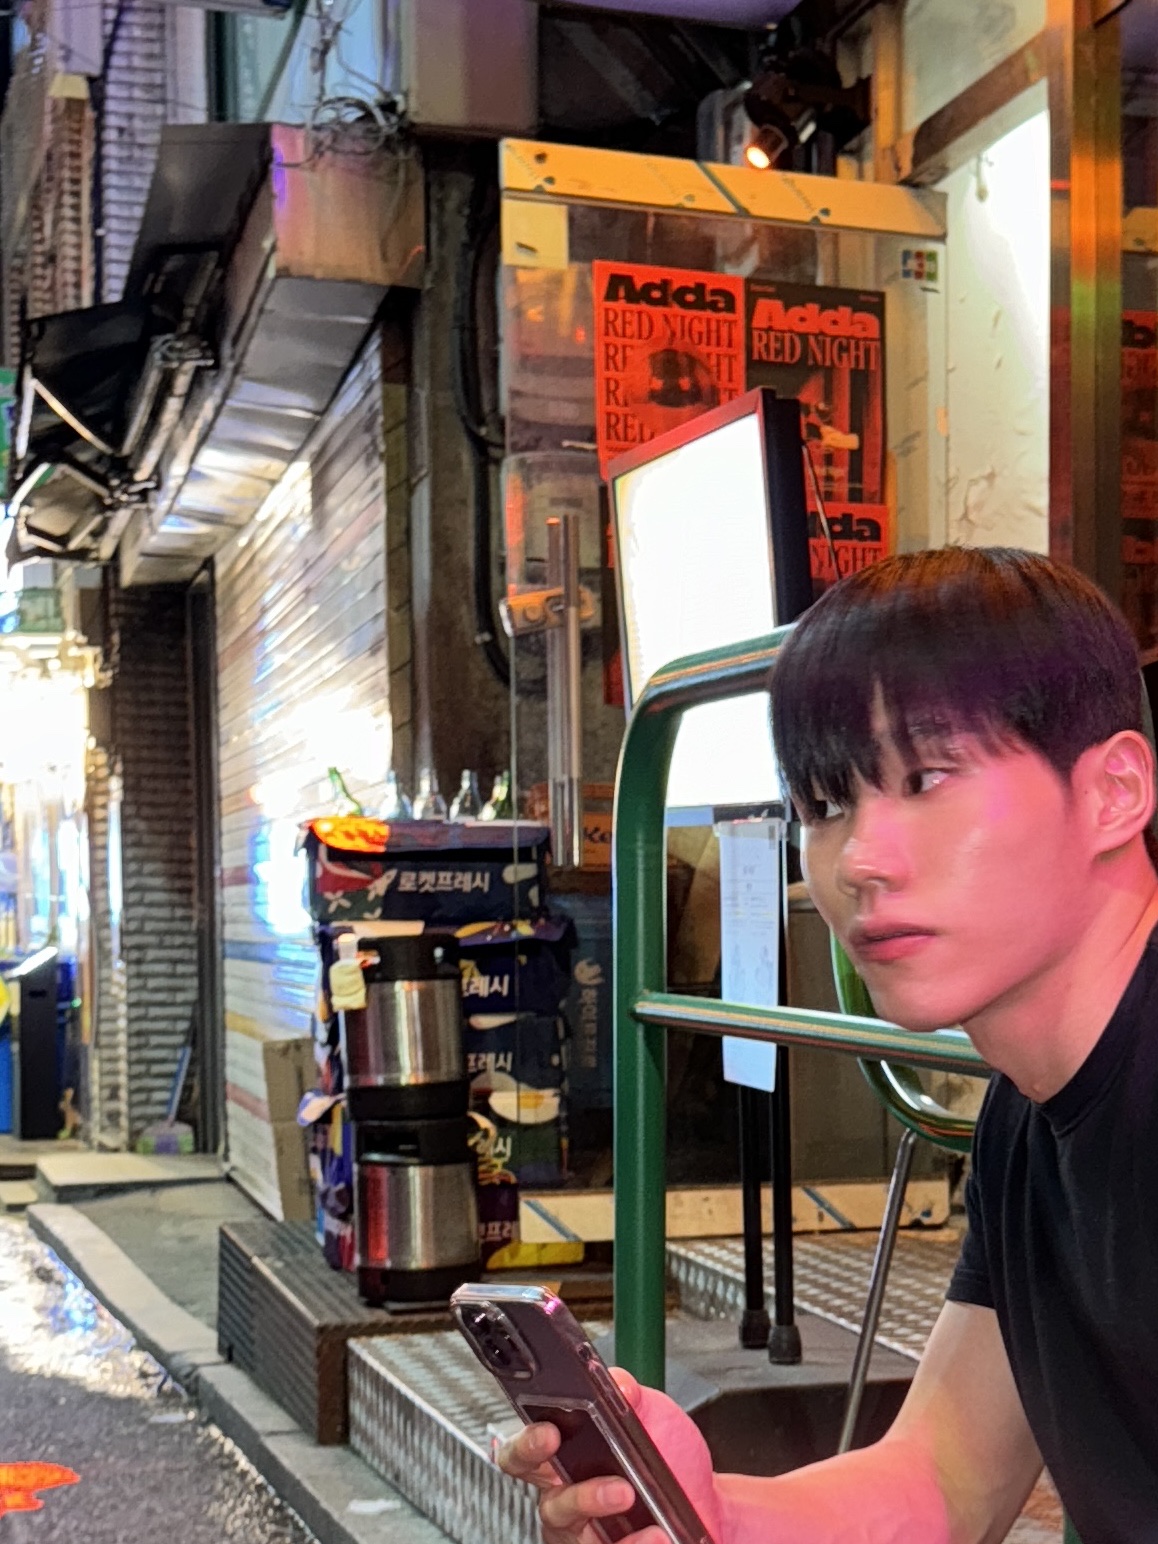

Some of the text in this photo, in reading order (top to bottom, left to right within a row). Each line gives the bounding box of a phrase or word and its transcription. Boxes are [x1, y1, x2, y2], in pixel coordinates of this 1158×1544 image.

[604, 273, 736, 314] Adda
[604, 307, 738, 349] RED NIGHT
[752, 298, 880, 339] Adda
[752, 329, 880, 371] RED NIGHT
[398, 870, 490, 894] 로켓프레시
